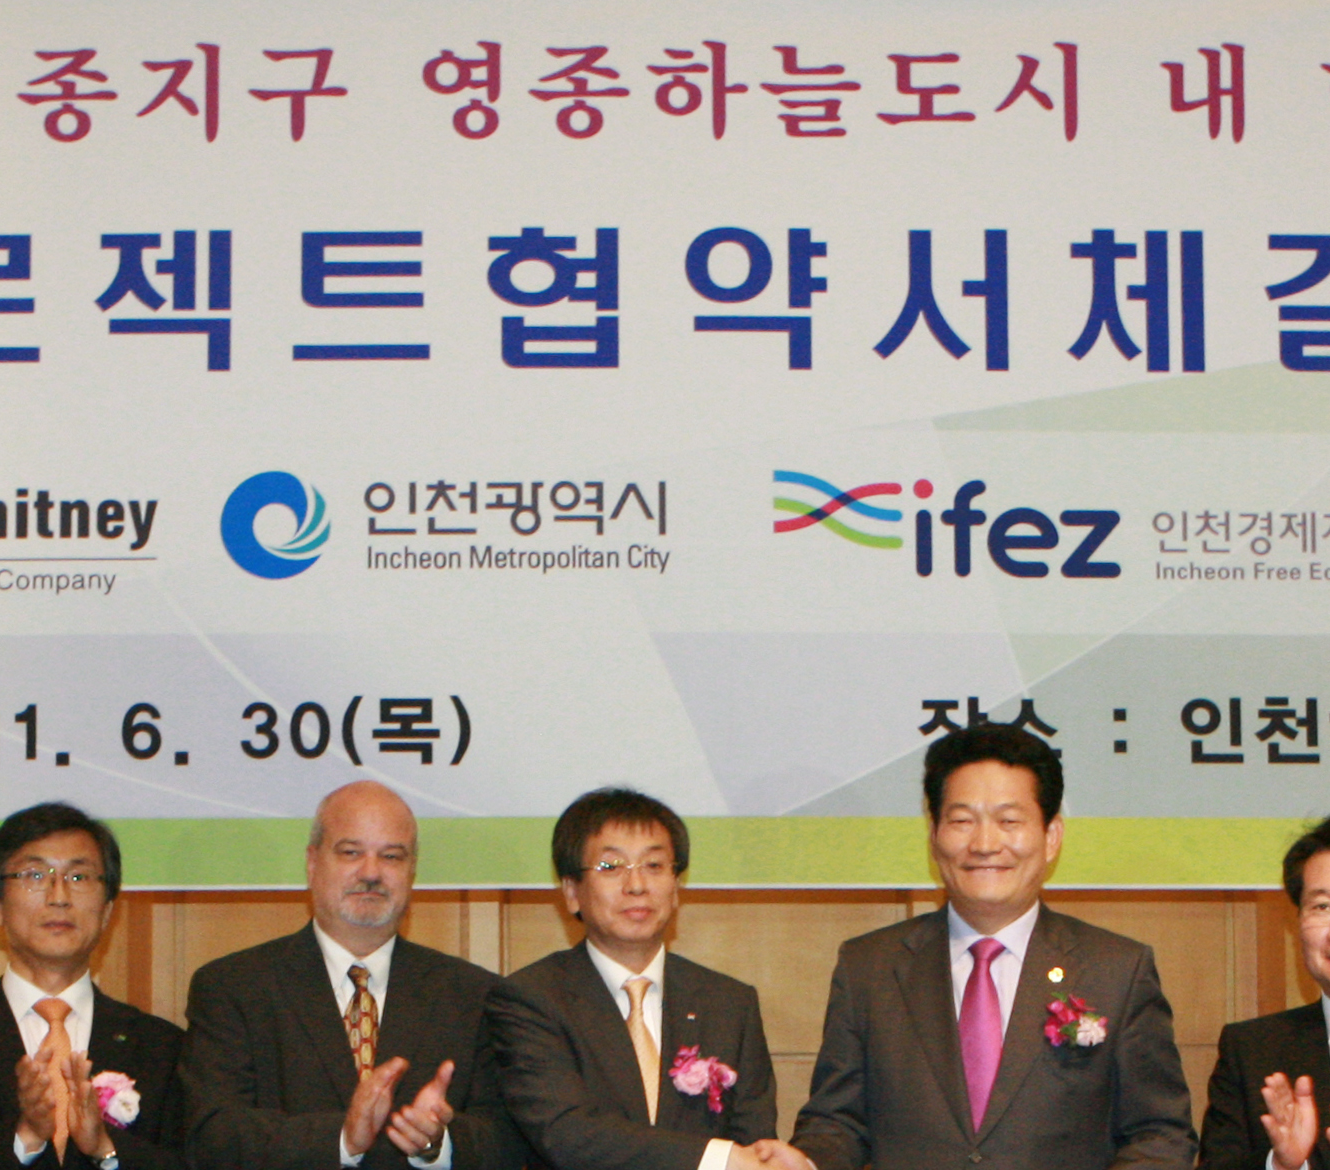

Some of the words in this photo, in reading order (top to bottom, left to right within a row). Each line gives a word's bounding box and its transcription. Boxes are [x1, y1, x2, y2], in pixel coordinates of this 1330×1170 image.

[422, 40, 1079, 142] 영종하늘도시
[1160, 42, 1246, 144] 내
[363, 479, 667, 537] 인천광역시
[913, 478, 1122, 579] ifez
[367, 545, 461, 570] Incheon
[469, 544, 620, 575] Metropolitan
[627, 543, 670, 574] City
[1156, 563, 1245, 579] Incheon
[1254, 562, 1301, 579] Free
[121, 701, 190, 767] 6.
[240, 694, 472, 767] 30(목)
[1112, 707, 1128, 755] :
